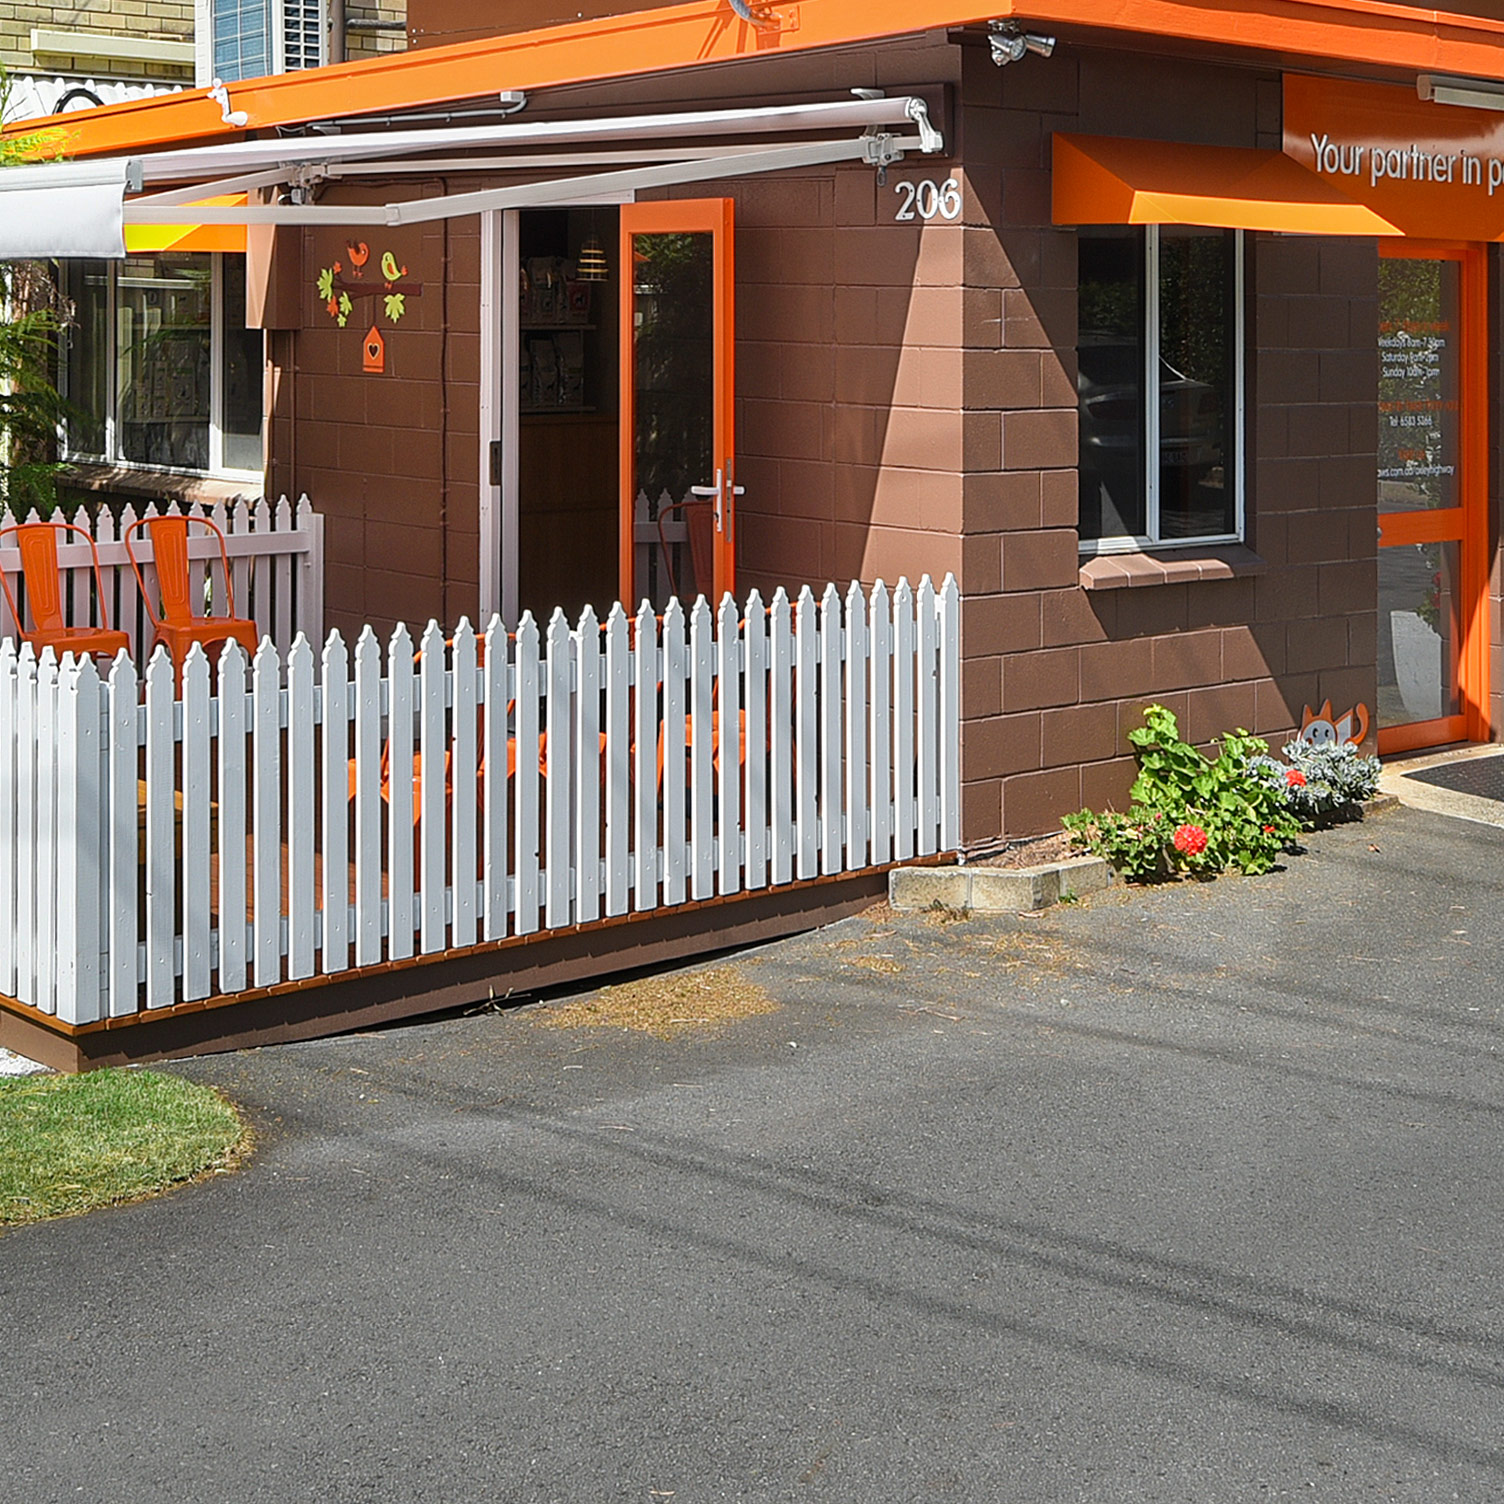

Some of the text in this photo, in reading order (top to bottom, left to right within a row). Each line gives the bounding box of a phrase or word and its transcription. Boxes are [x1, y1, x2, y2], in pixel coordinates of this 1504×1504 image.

[1310, 133, 1363, 176] Your
[1371, 143, 1455, 187] partner
[1461, 150, 1481, 186] in
[895, 178, 961, 220] 206
[1382, 365, 1405, 379] Sunday
